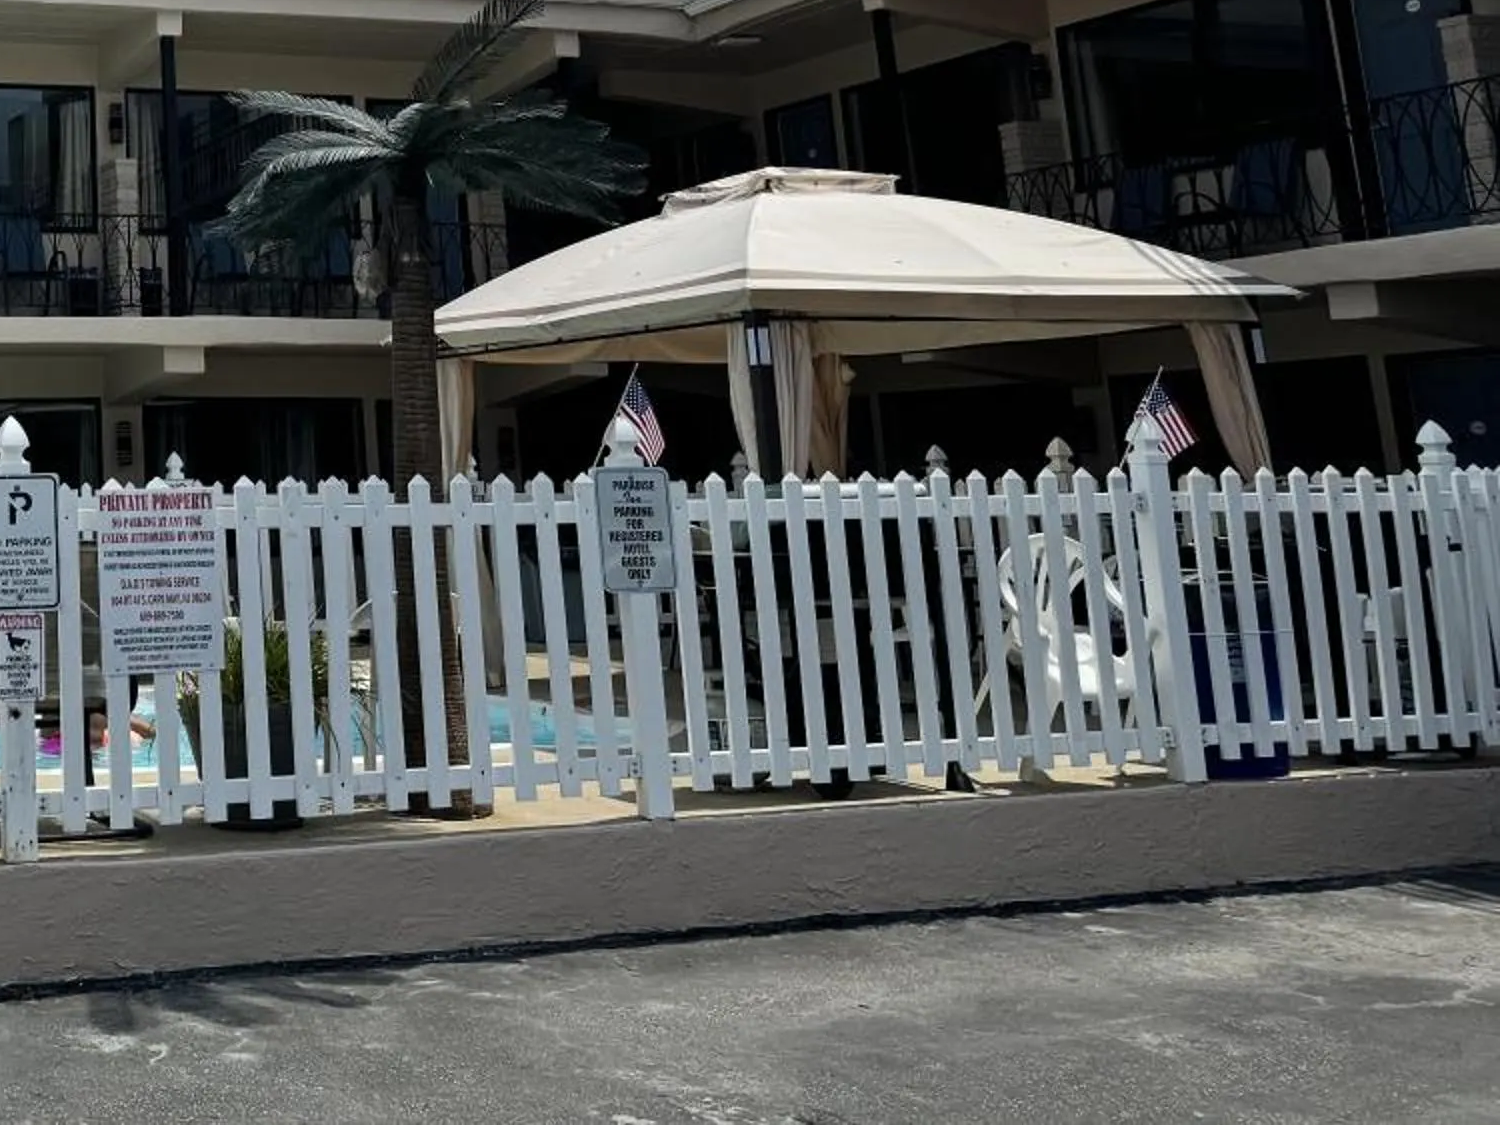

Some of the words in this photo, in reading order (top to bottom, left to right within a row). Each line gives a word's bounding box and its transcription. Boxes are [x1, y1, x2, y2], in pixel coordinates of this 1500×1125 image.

[612, 480, 655, 492] PARADISE
[99, 493, 149, 512] PRIVATE
[152, 492, 213, 511] PROPERTY
[613, 506, 654, 518] PARKING
[124, 516, 157, 528] PARKING
[626, 518, 644, 530] FOR
[5, 536, 52, 548] PARKING
[609, 531, 663, 543] REGISTERED
[623, 543, 650, 555] HOTEL
[621, 556, 656, 568] GUESTS
[26, 567, 53, 576] AWAY
[628, 569, 651, 581] ONLY
[173, 576, 201, 588] SERVICE
